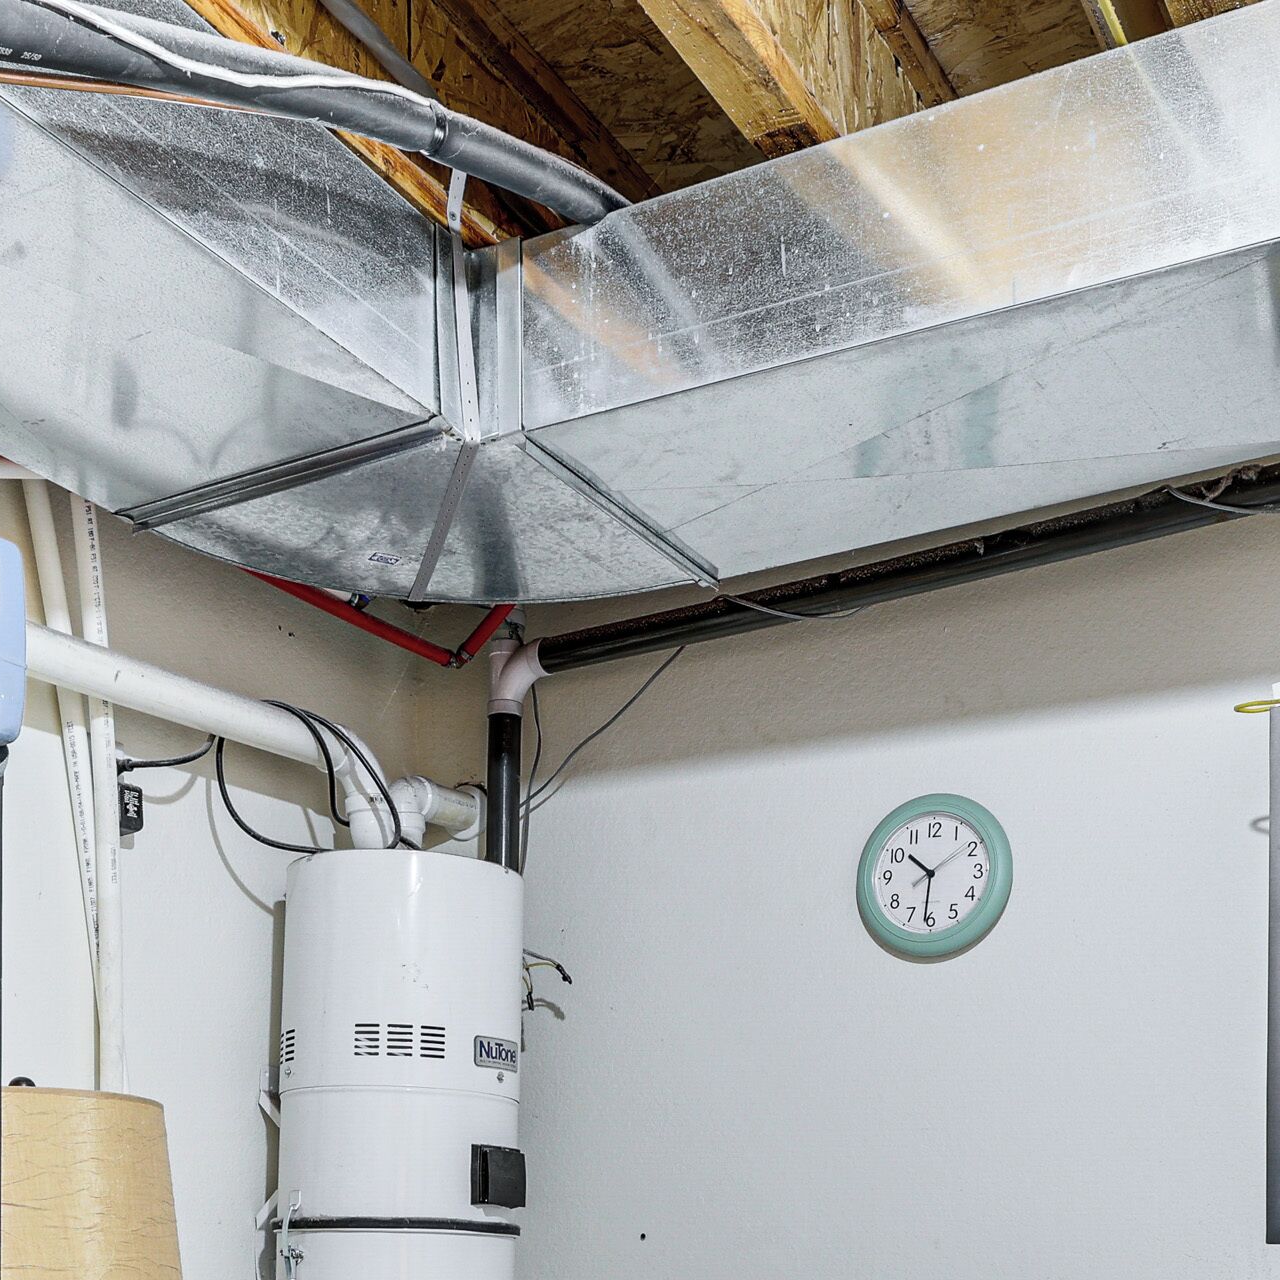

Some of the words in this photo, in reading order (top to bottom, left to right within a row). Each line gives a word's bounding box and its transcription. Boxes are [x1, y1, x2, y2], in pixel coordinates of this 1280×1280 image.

[909, 829, 918, 845] 11
[927, 822, 942, 838] 12
[955, 826, 958, 841] 1
[890, 847, 905, 864] 10
[967, 841, 978, 857] 2
[883, 870, 893, 885] 9
[973, 863, 984, 879] 3
[890, 893, 900, 909] 8
[964, 885, 975, 901] 4
[906, 907, 916, 923] 7
[926, 911, 936, 927] 6
[948, 903, 958, 920] 5
[479, 1040, 516, 1063] NuTone
